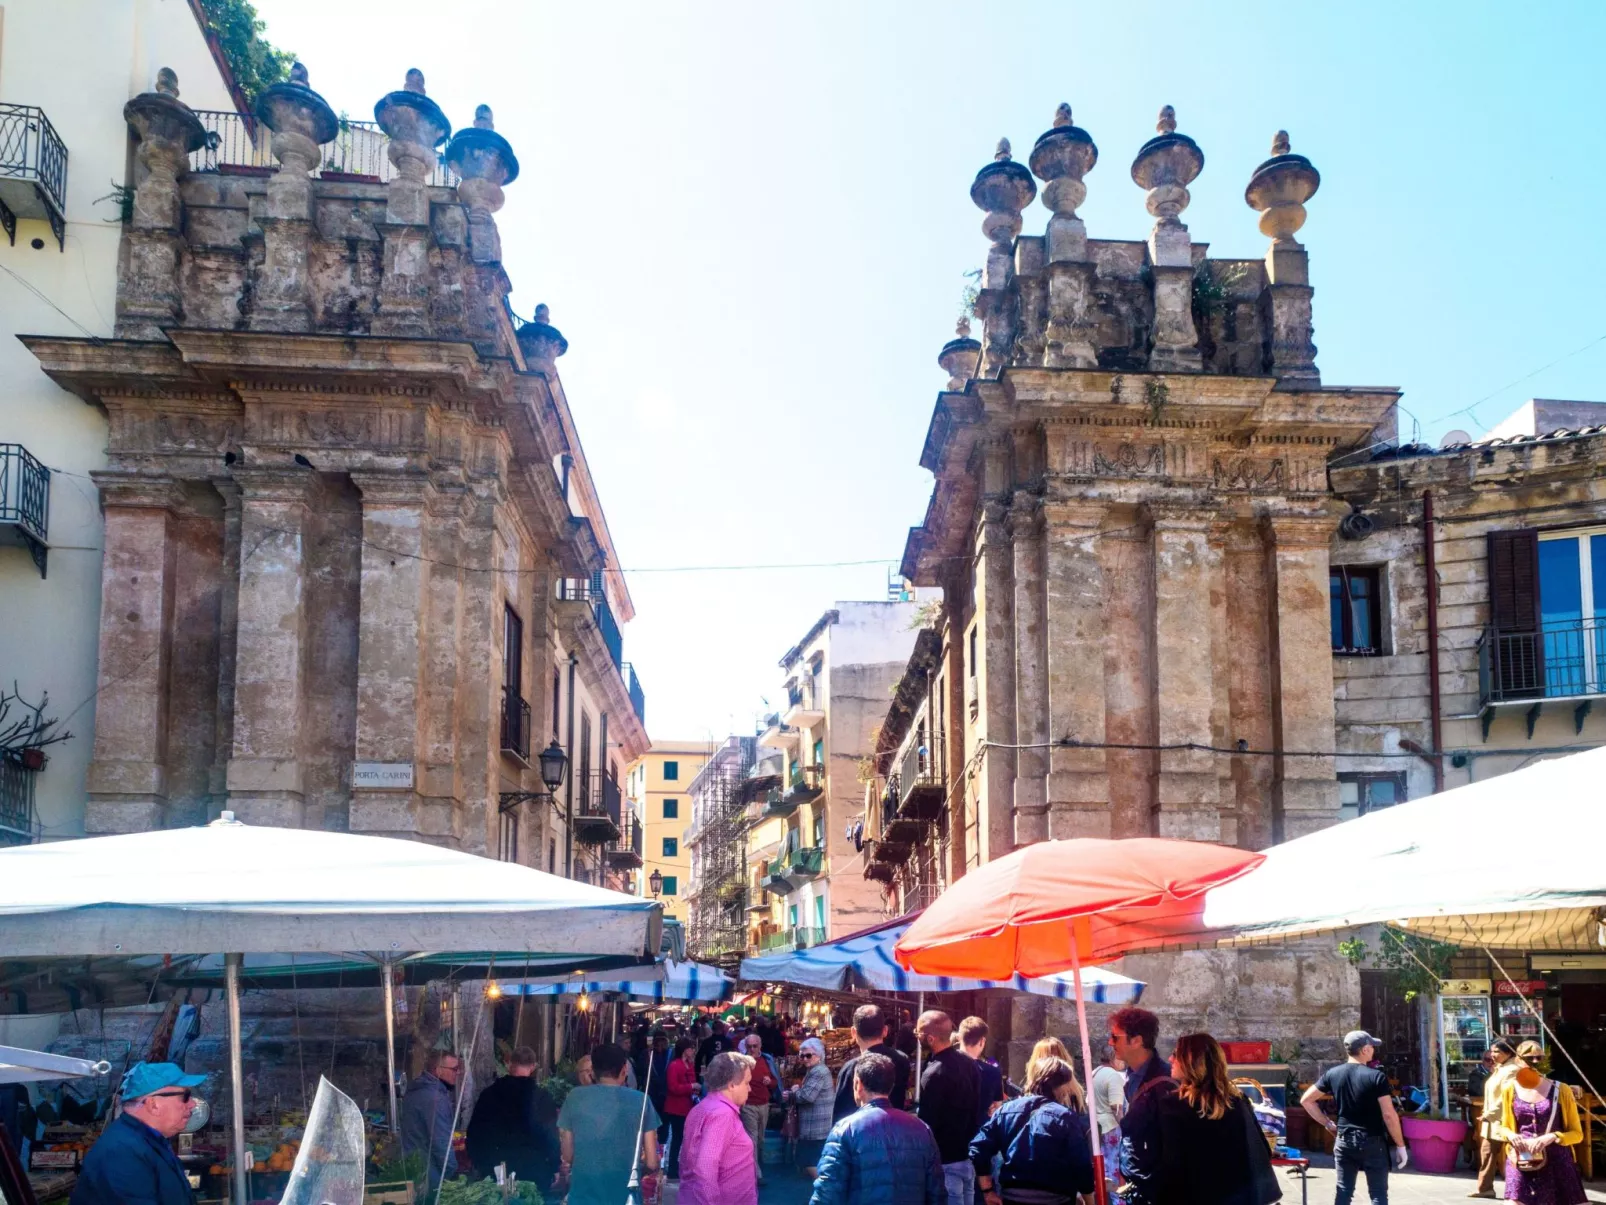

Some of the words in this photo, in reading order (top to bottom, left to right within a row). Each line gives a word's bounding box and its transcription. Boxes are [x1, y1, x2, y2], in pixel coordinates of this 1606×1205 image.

[355, 771, 379, 779] PORTA
[382, 771, 411, 779] CARINI
[1497, 981, 1530, 993] CocaCola
[715, 1041, 722, 1051] 3
